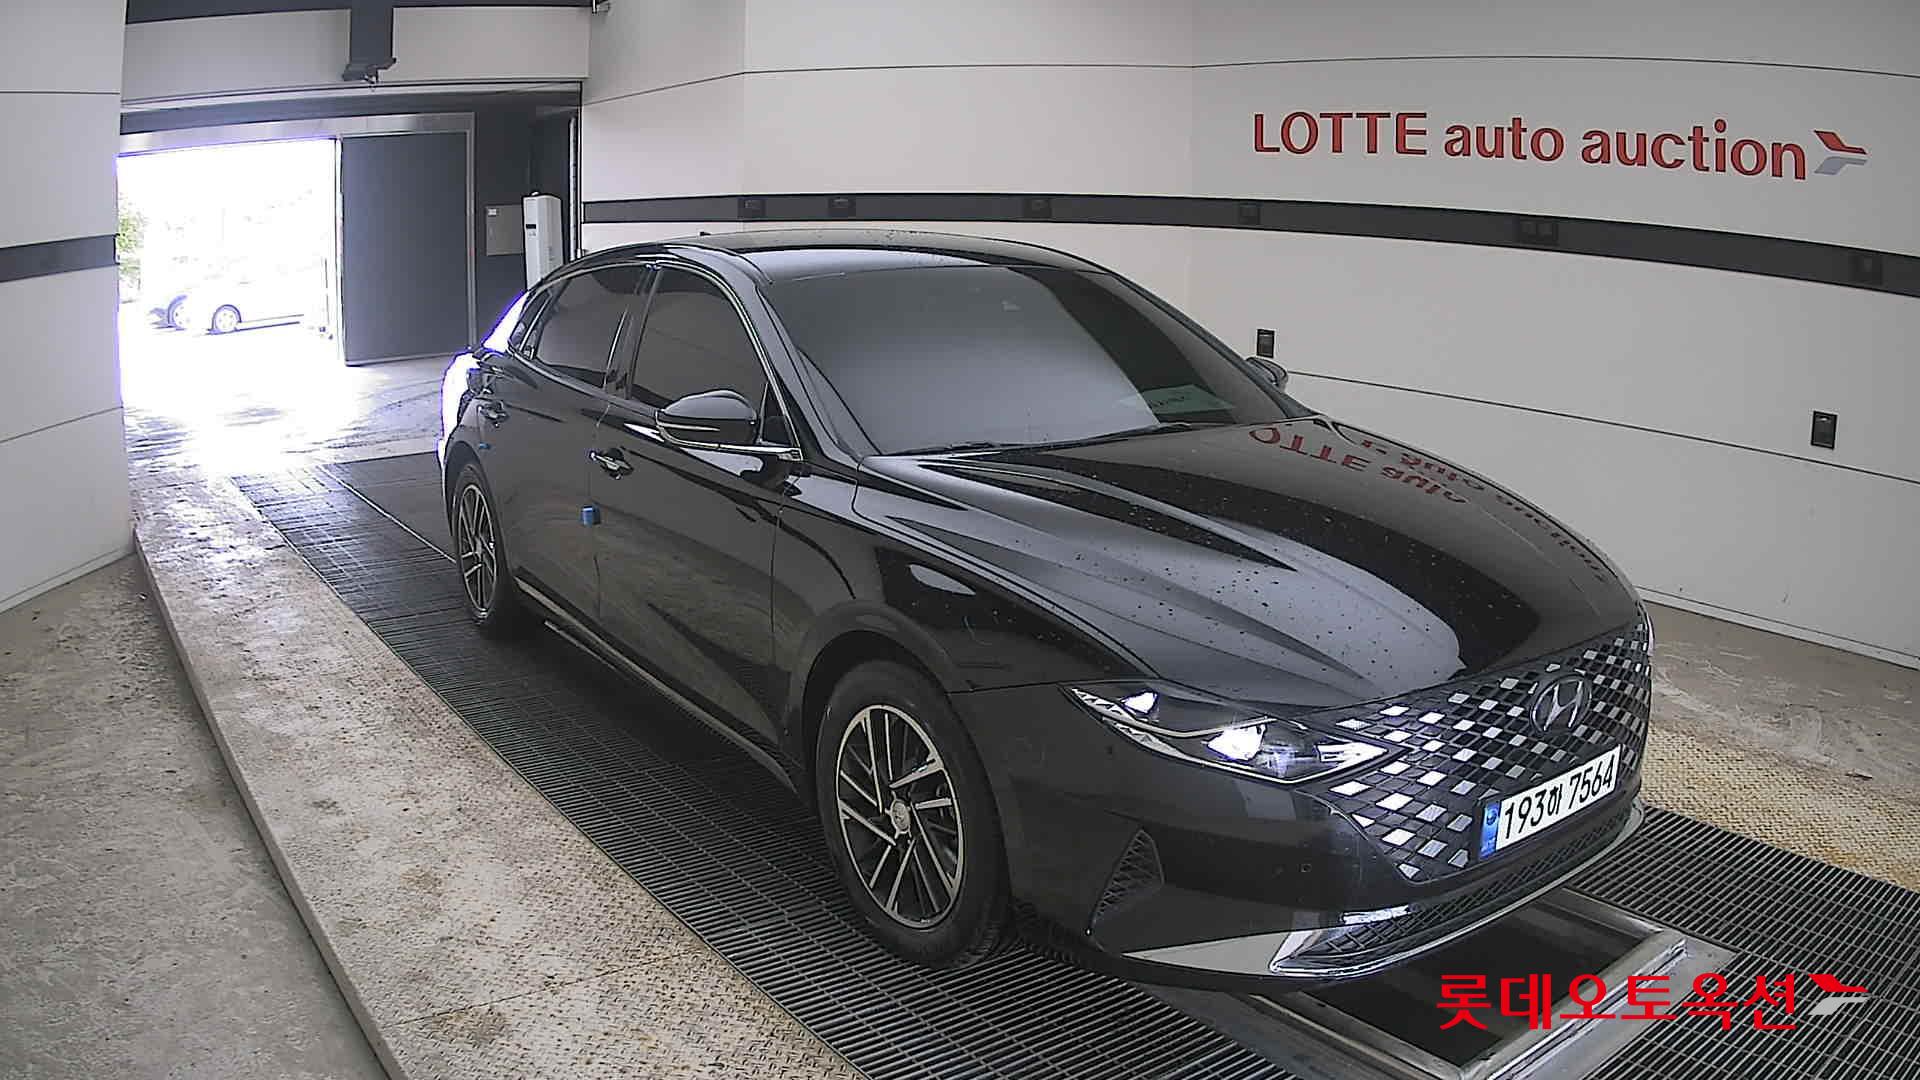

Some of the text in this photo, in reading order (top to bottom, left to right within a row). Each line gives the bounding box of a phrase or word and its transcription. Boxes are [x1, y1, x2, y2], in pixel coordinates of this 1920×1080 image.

[1254, 112, 1807, 180] LOTTE auto auction
[1504, 753, 1616, 840] 193하 7564
